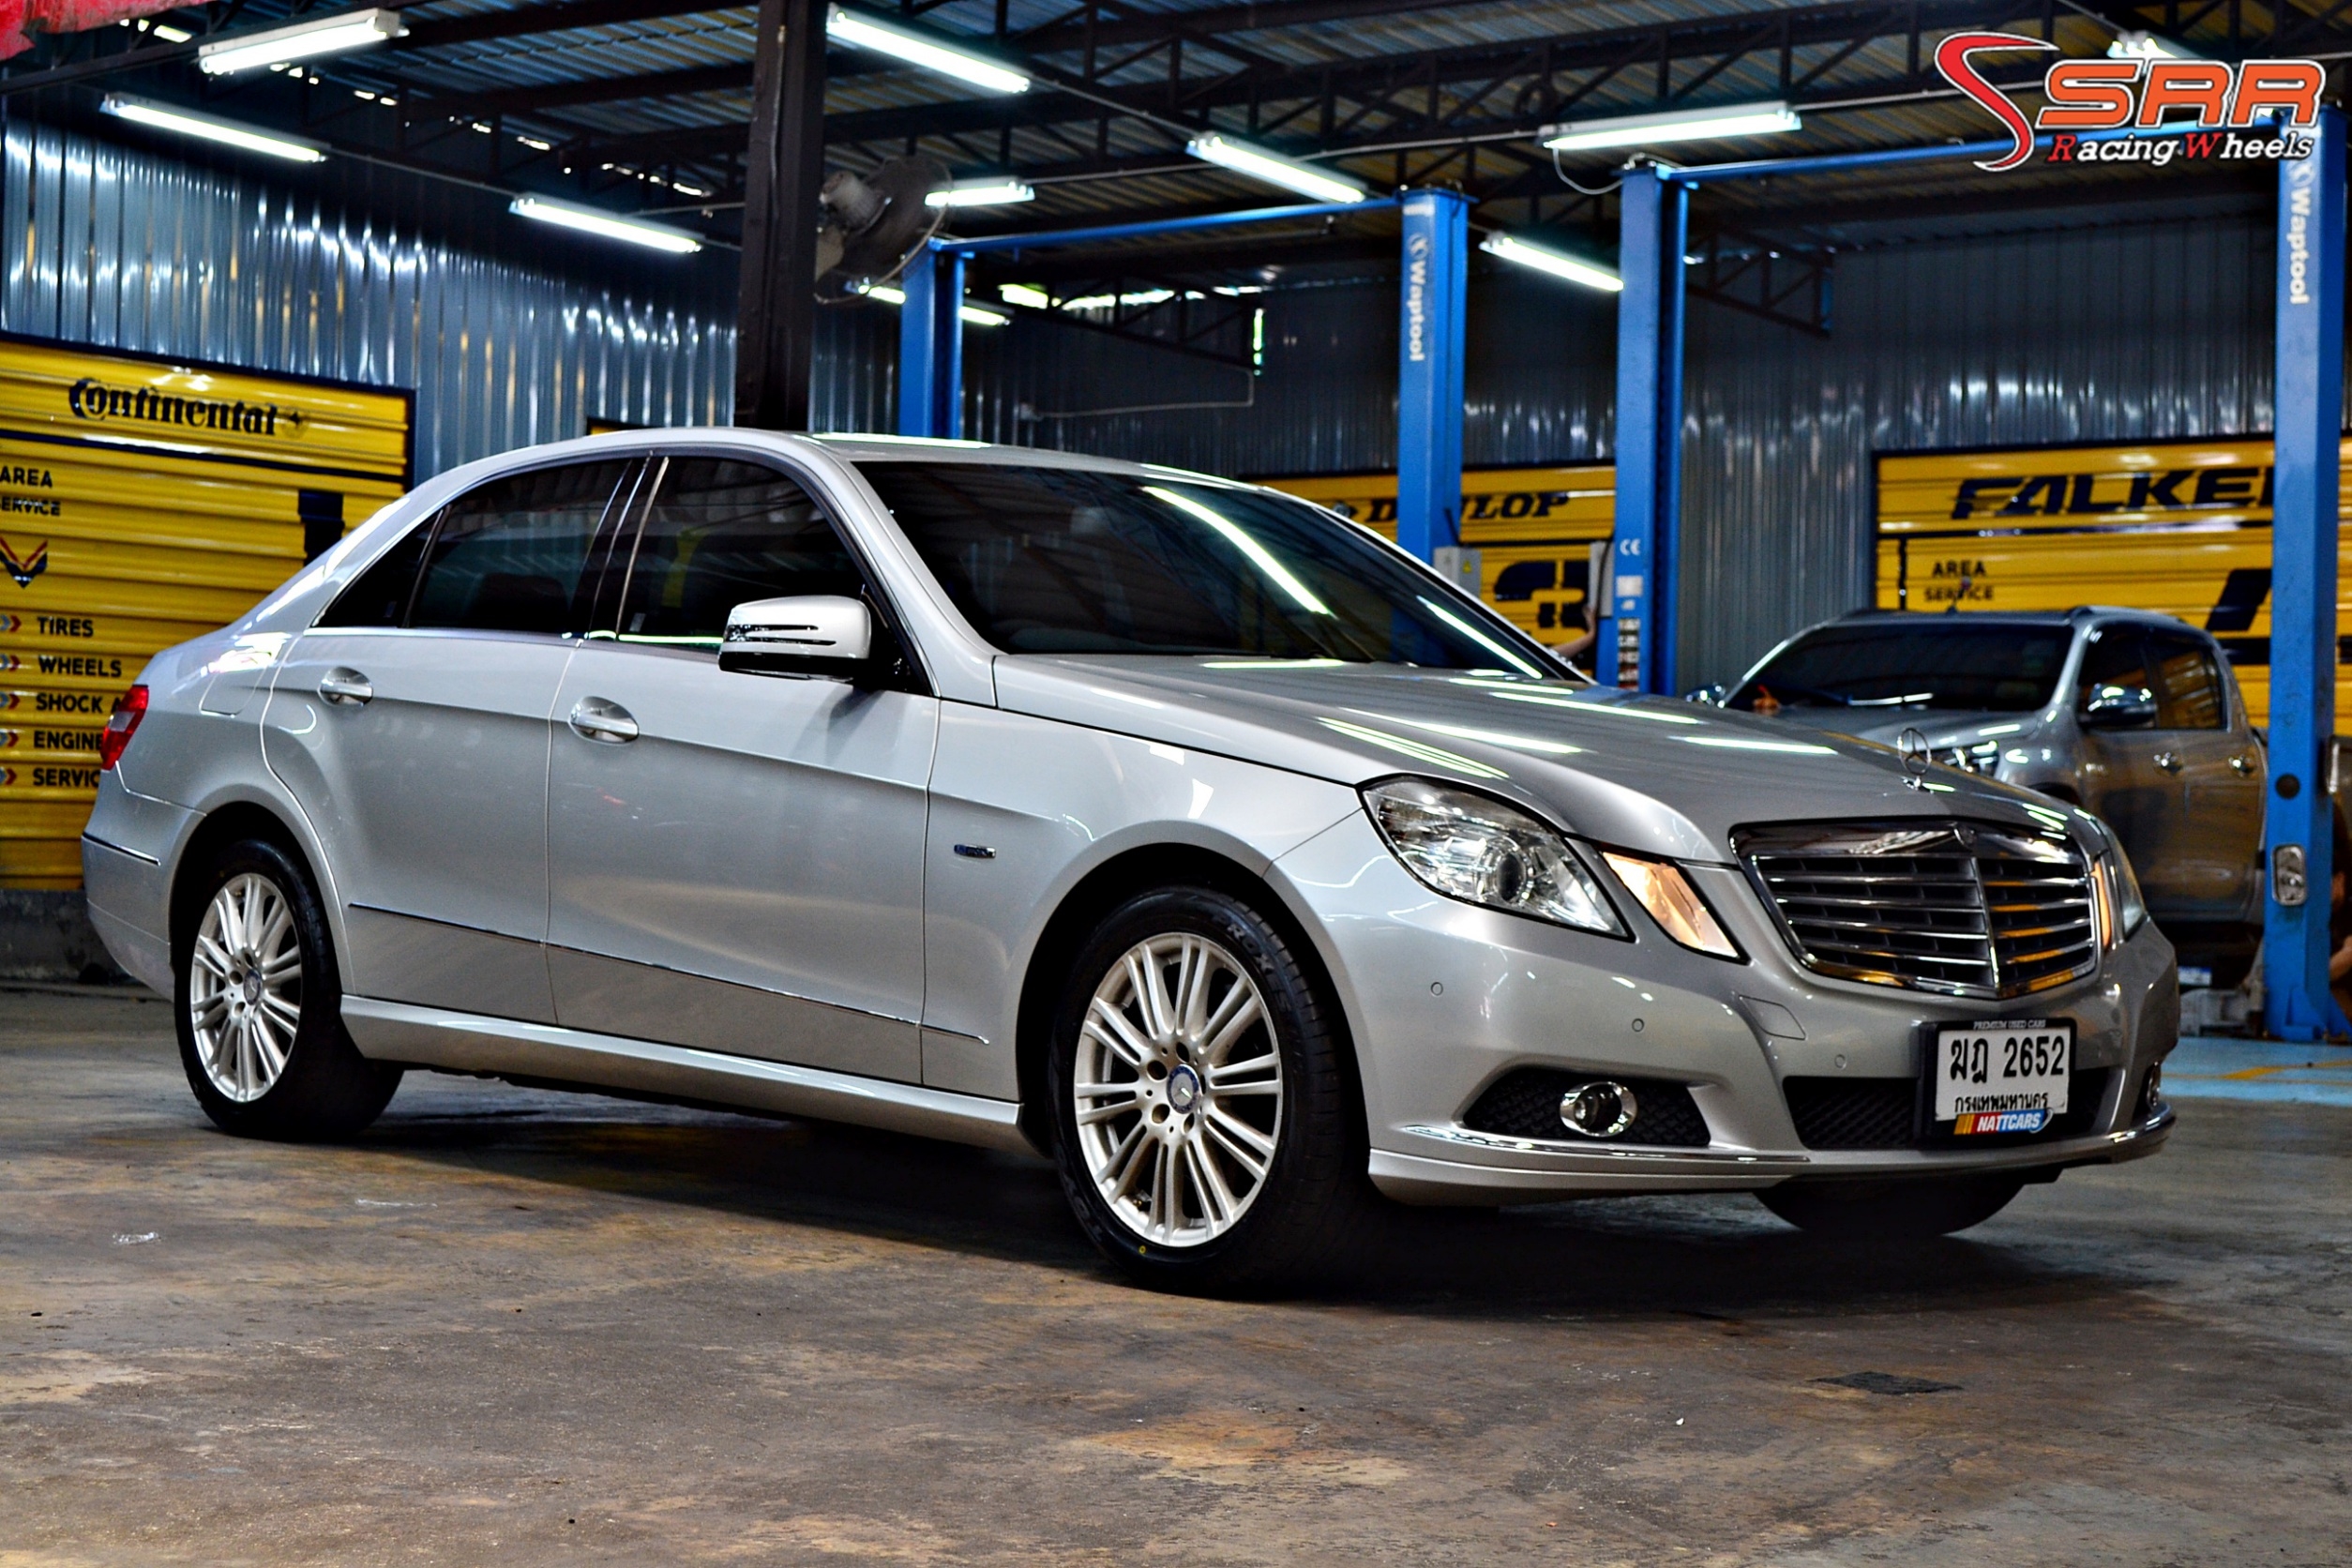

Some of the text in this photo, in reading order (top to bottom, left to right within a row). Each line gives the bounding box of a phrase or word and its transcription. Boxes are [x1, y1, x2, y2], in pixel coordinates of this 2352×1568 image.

[2286, 187, 2311, 305] Waptool
[1407, 260, 1426, 362] Waptool
[69, 378, 278, 435] Continental
[0, 466, 53, 489] AREA
[0, 496, 61, 517] ERVICE
[1365, 492, 1569, 522] DLOP
[1932, 560, 1986, 578] AREA
[37, 616, 94, 637] TIRES
[38, 656, 122, 677] WHEELS
[36, 693, 103, 714] SHOCK
[33, 768, 100, 788] SERVIC
[2028, 1019, 2046, 1029] CARS
[2003, 1035, 2065, 1078] 2652
[1977, 1112, 2042, 1133] NATTCARS
